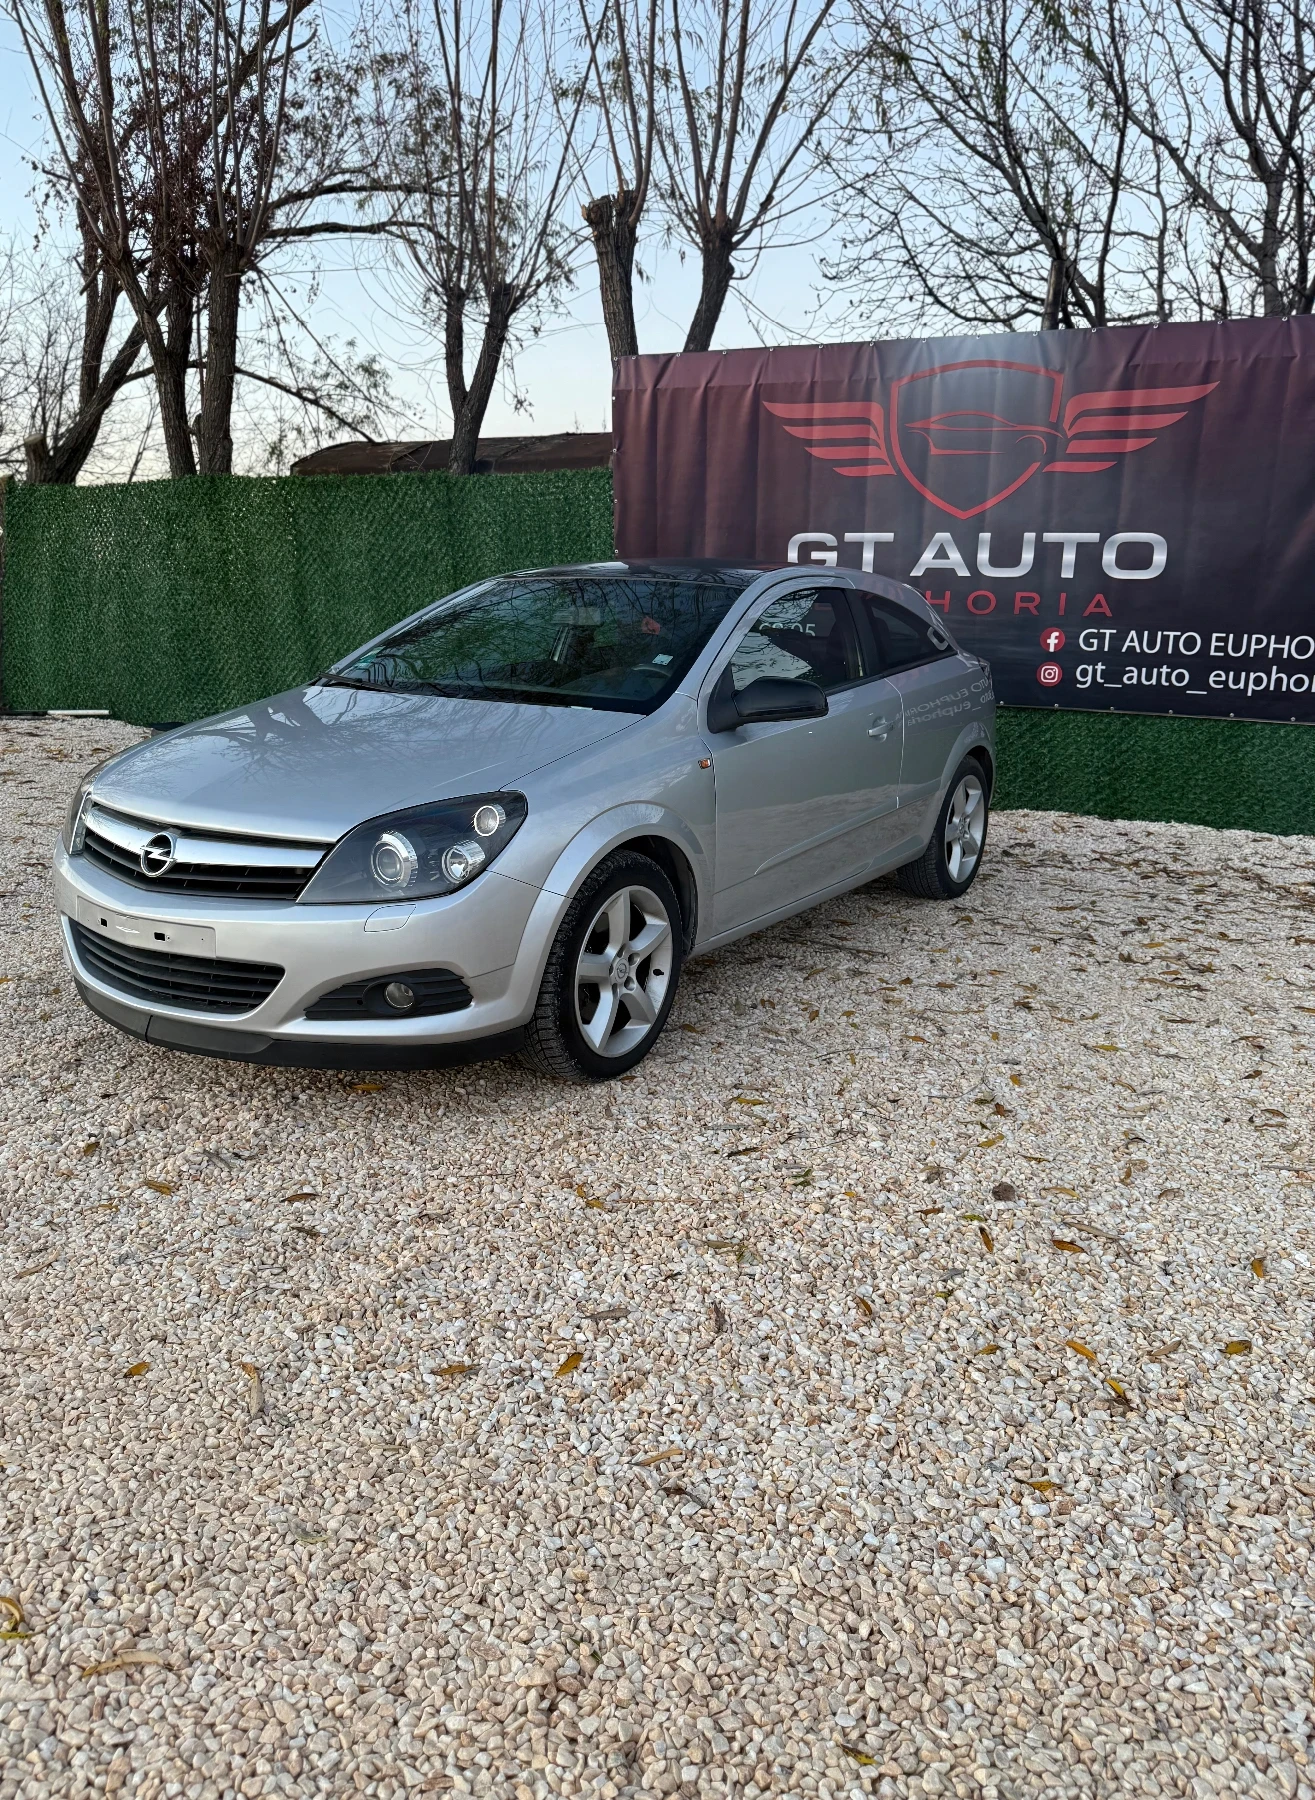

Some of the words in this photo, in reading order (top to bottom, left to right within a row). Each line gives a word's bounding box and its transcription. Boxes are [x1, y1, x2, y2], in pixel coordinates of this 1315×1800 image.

[787, 532, 895, 573] GT
[910, 532, 1168, 579] AUTO
[1078, 628, 1117, 652] GT
[1121, 630, 1202, 655] AUTO
[1209, 632, 1315, 660] EUPHO
